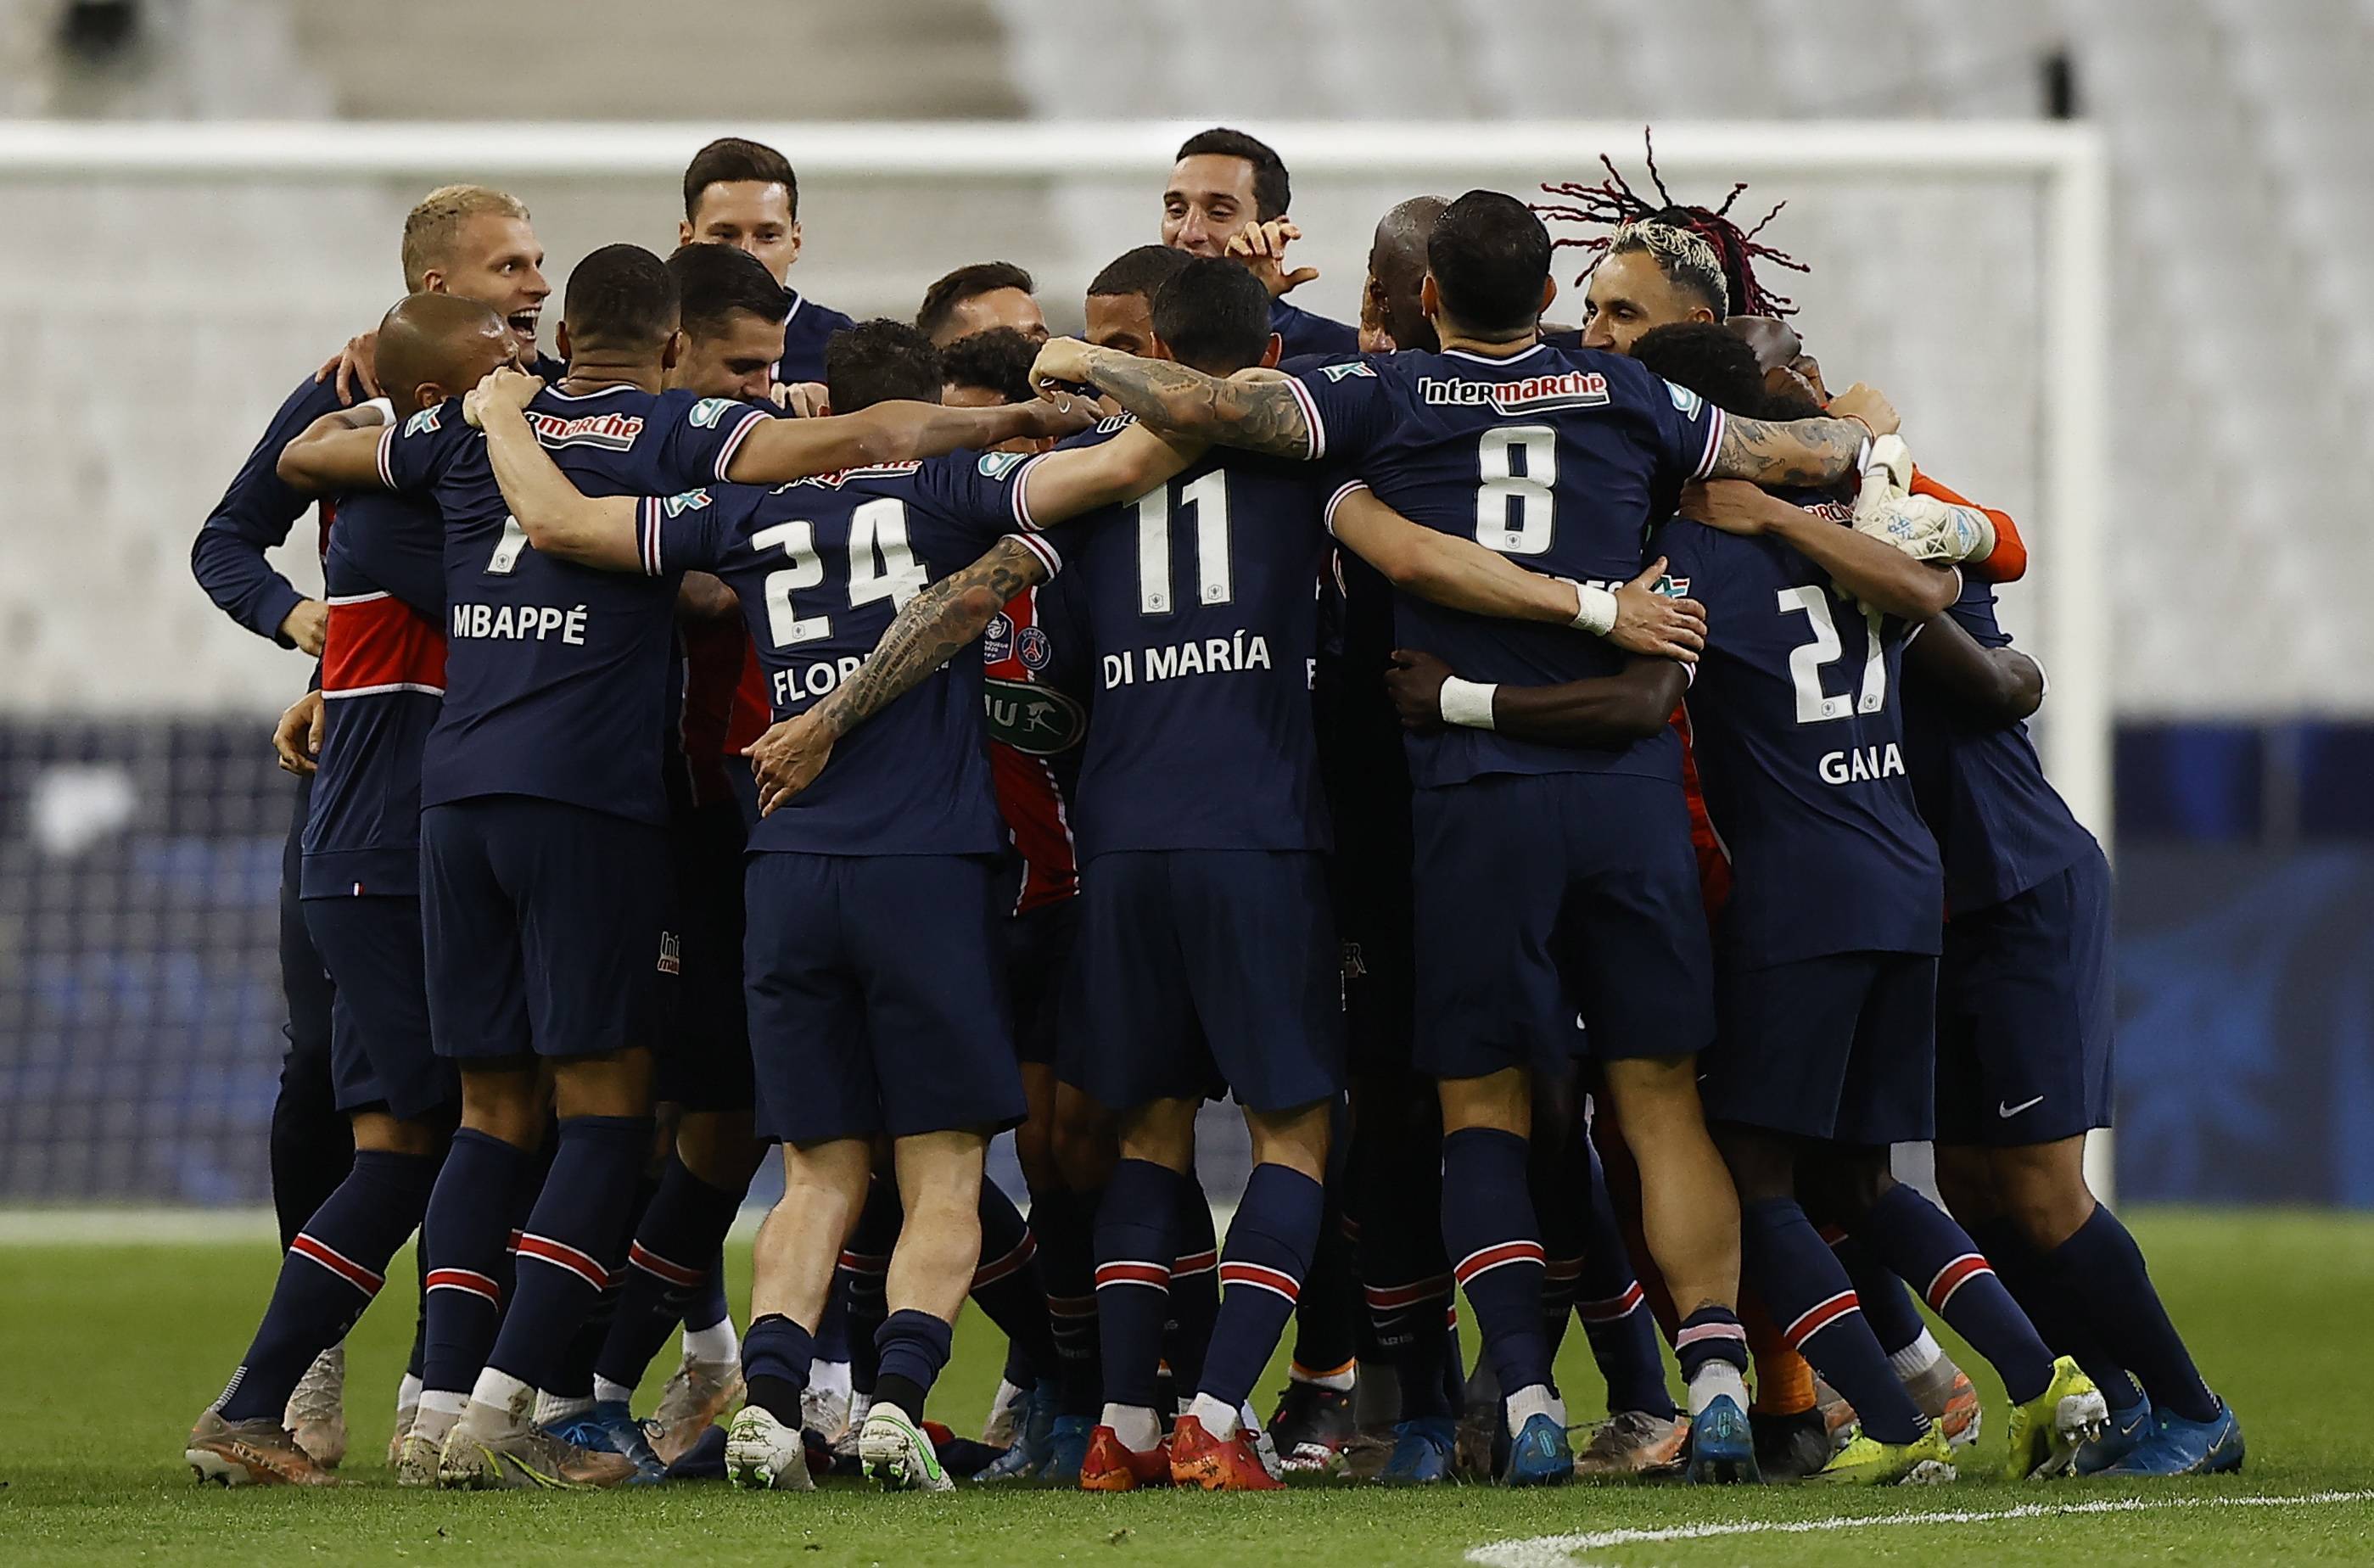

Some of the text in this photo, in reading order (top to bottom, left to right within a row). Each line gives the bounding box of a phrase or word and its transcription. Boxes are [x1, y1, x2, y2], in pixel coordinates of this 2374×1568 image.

[524, 412, 643, 440] marché
[1476, 425, 1556, 554] 8
[751, 498, 929, 648] 24
[1123, 468, 1231, 613] 11
[452, 604, 587, 646] MBAPPÉ
[1104, 630, 1271, 689] DI MARÍA
[1777, 585, 1886, 724] 27
